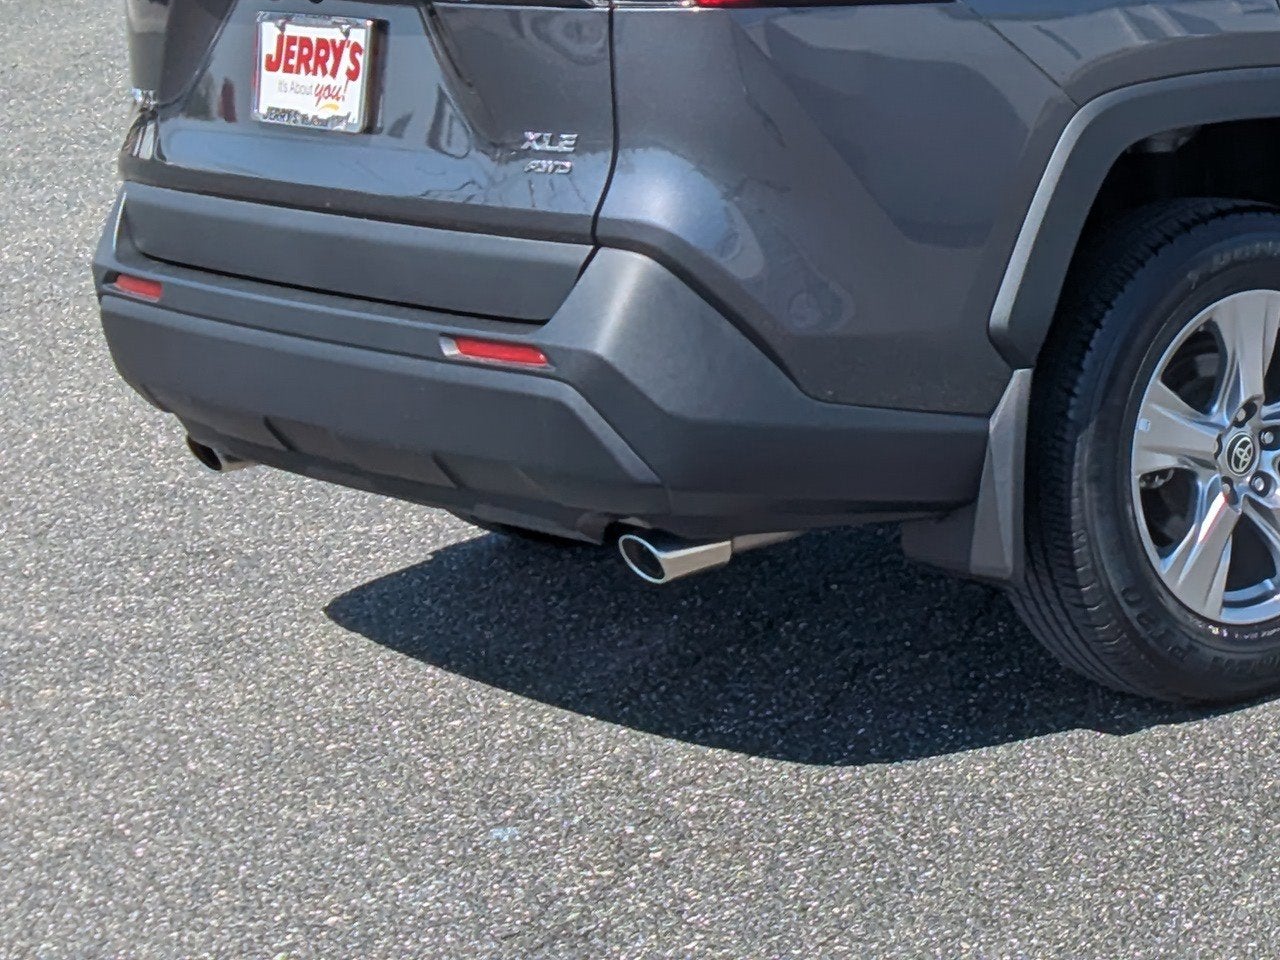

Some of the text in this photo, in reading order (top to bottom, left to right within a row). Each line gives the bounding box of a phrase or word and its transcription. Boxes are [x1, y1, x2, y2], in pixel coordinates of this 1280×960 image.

[265, 34, 363, 82] JERRY'S
[289, 81, 314, 96] About
[314, 79, 349, 108] you!
[521, 131, 578, 152] XLE
